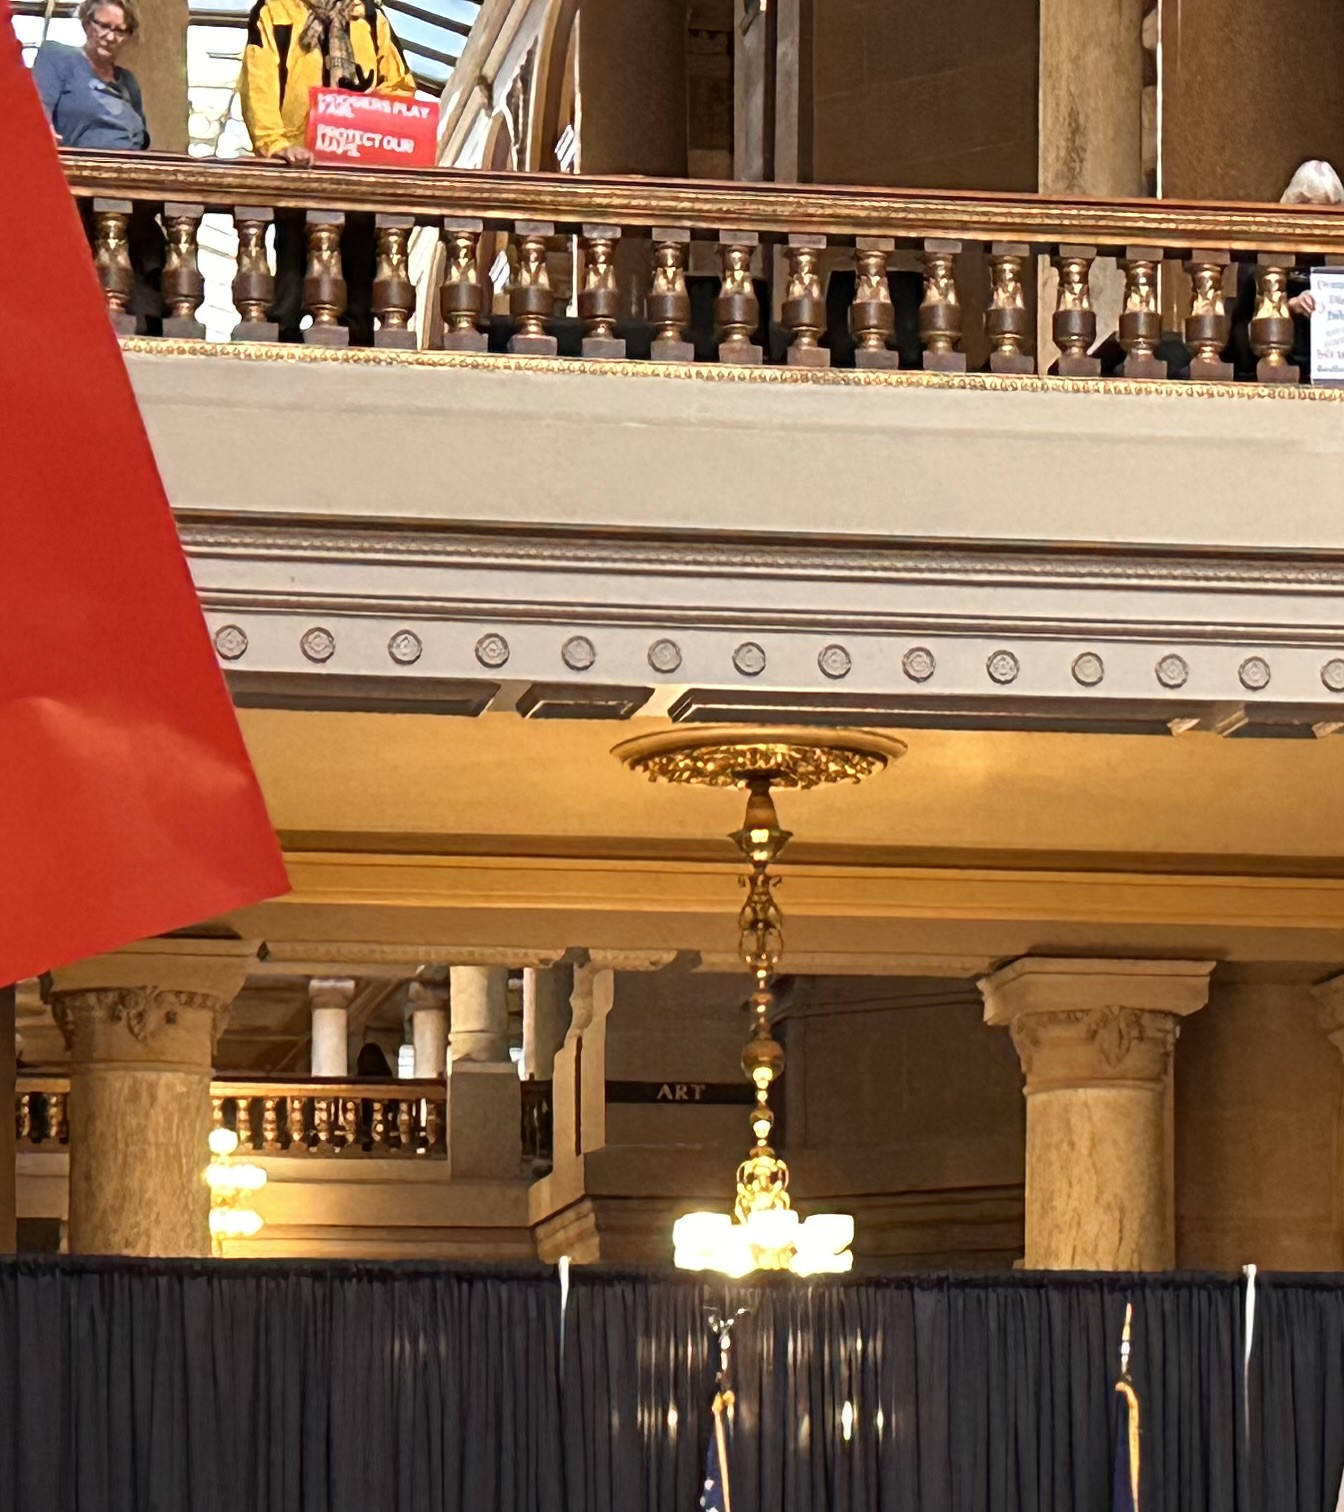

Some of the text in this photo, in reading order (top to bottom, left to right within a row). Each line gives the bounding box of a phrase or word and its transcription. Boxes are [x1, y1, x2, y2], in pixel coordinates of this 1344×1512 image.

[393, 102, 430, 119] PLAY
[383, 135, 415, 153] OUR
[657, 1083, 705, 1100] ART
